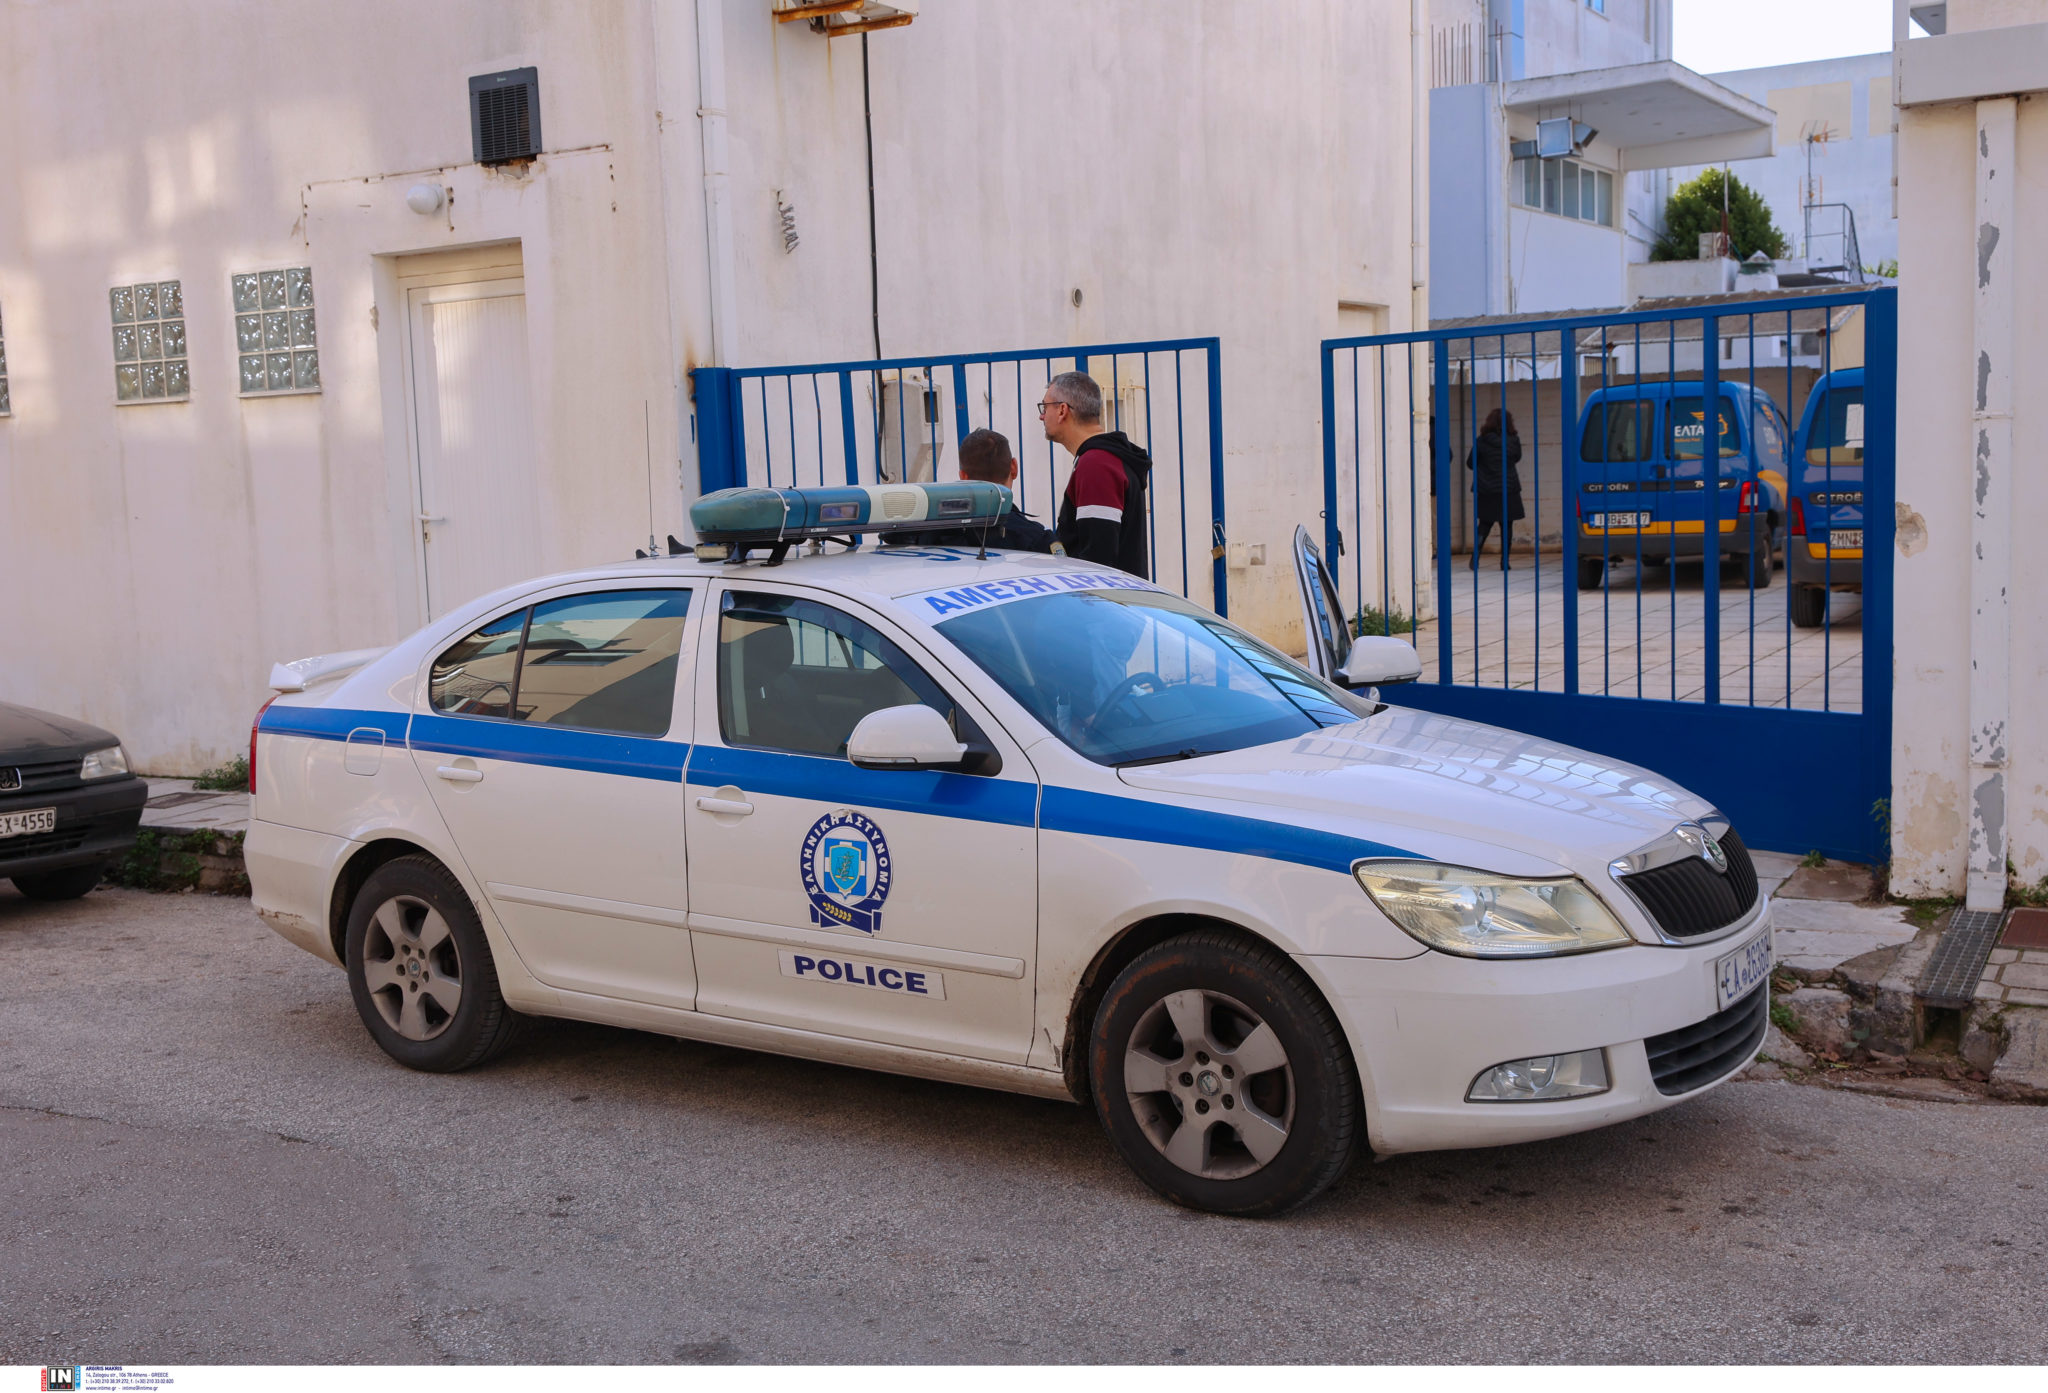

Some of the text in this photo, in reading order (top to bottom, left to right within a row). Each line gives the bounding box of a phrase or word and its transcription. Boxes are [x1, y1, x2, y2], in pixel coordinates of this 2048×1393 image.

[1588, 483, 1629, 492] CITOËN
[924, 577, 1059, 615] ΑΜΕΣΗ
[803, 813, 890, 902] ΕΛΛΗΝΙΚΗ ΑΣΤΥΝΟΜΙΑ
[793, 955, 928, 994] POLICE
